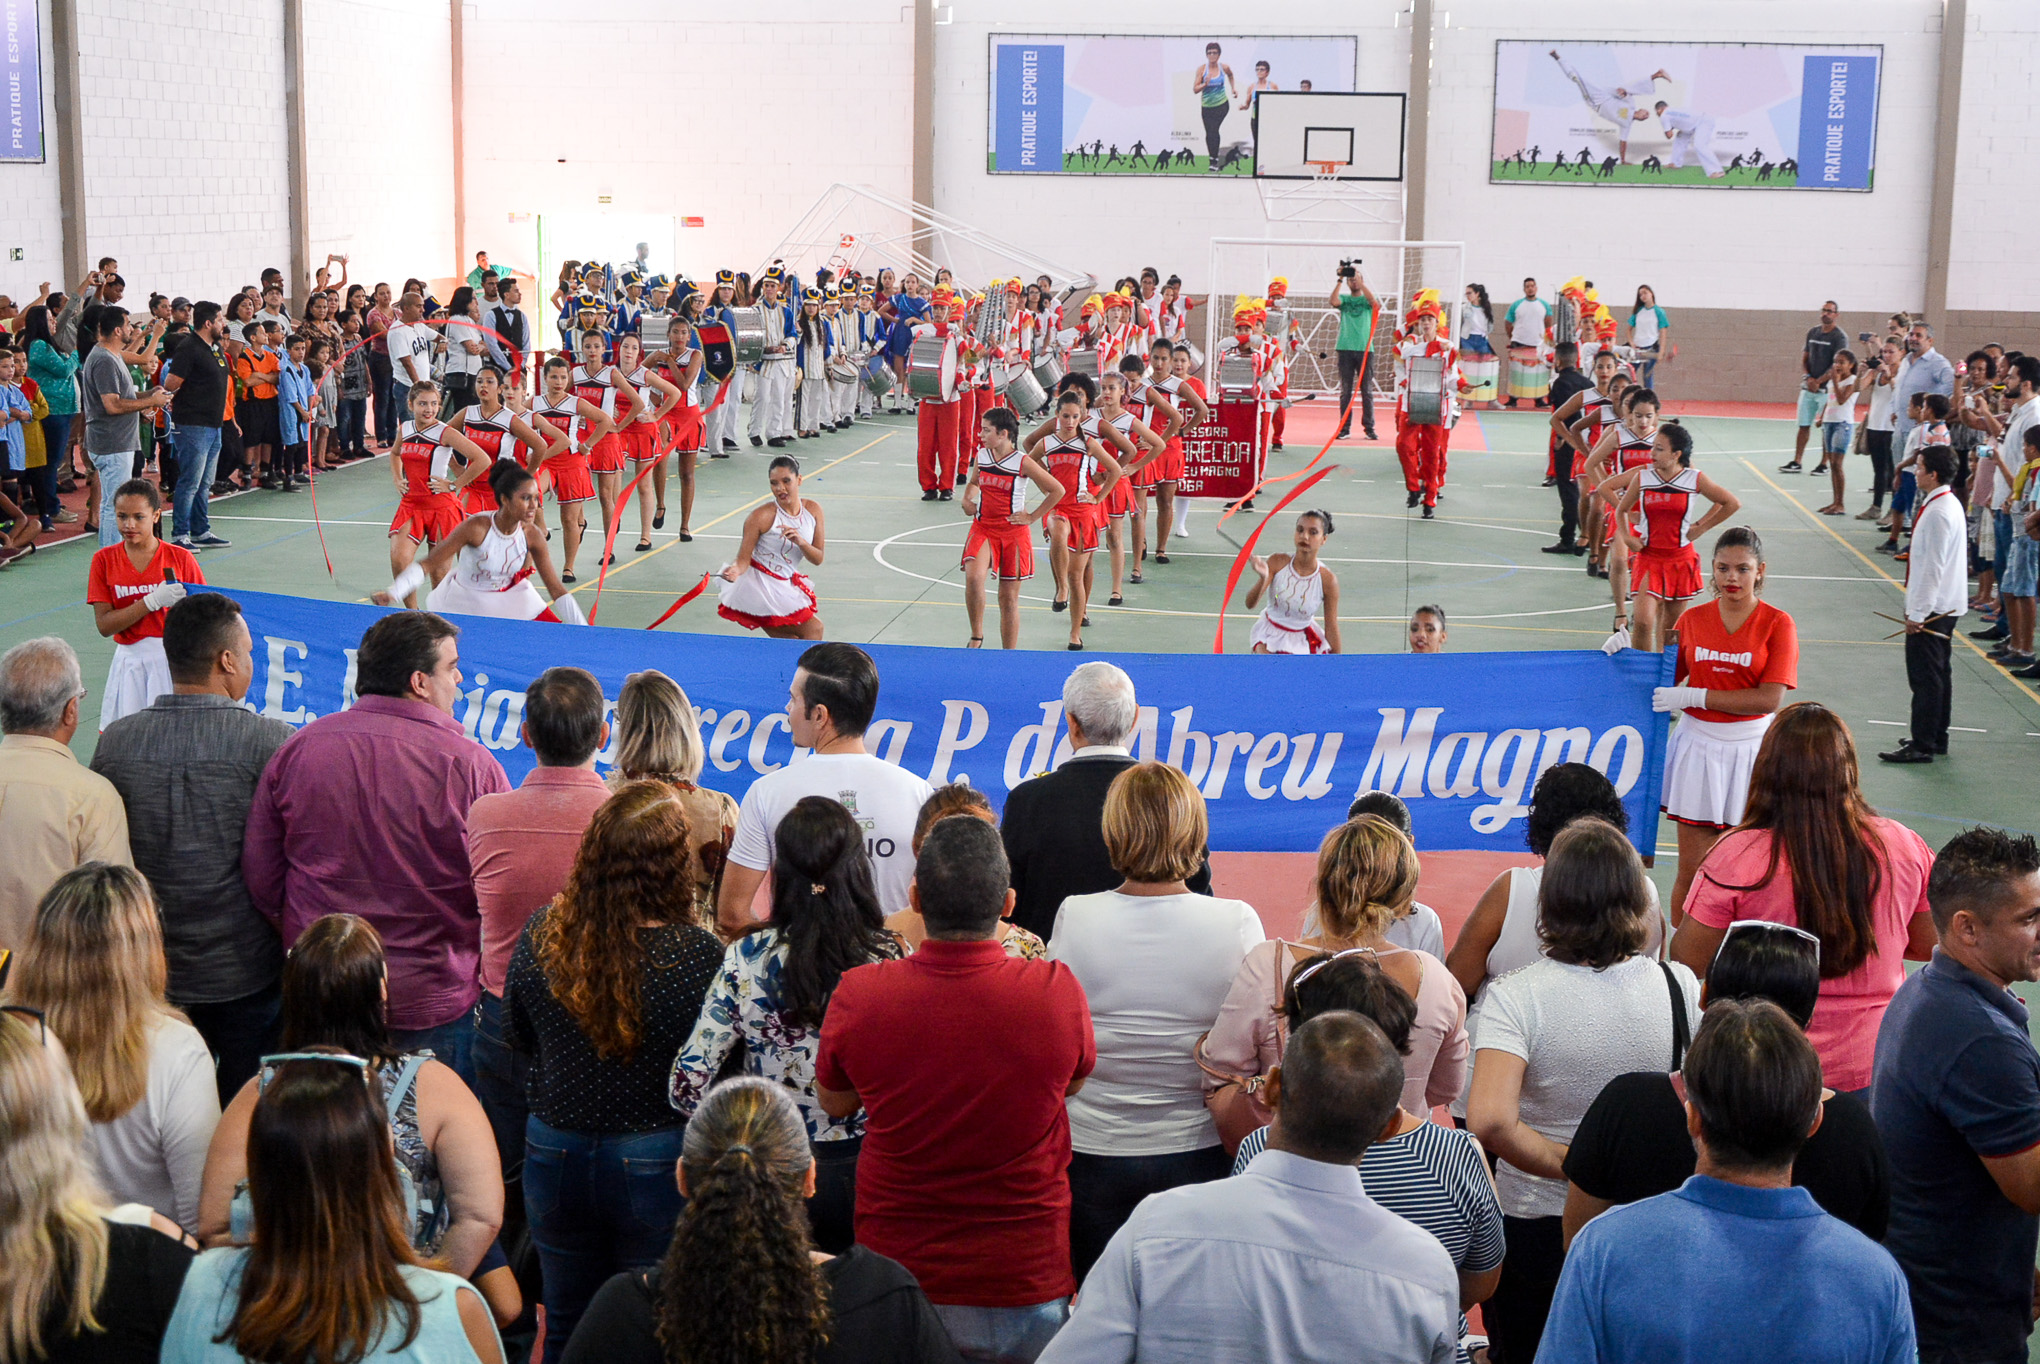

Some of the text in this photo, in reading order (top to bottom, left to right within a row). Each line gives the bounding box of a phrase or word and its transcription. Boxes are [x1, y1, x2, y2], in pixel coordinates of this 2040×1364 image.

[7, 0, 23, 149] PRATIQUE ESPORT
[1021, 50, 1038, 166] PRATIQUE ESPORTE!
[1823, 61, 1848, 182] PRATIQUE ESPORTE!
[1182, 441, 1251, 463] ARECIDA
[1200, 466, 1240, 477] MAGNO
[114, 583, 159, 599] MAGN
[1695, 646, 1752, 668] MAGNO
[1353, 706, 1645, 834] Magno
[867, 838, 896, 858] IO
